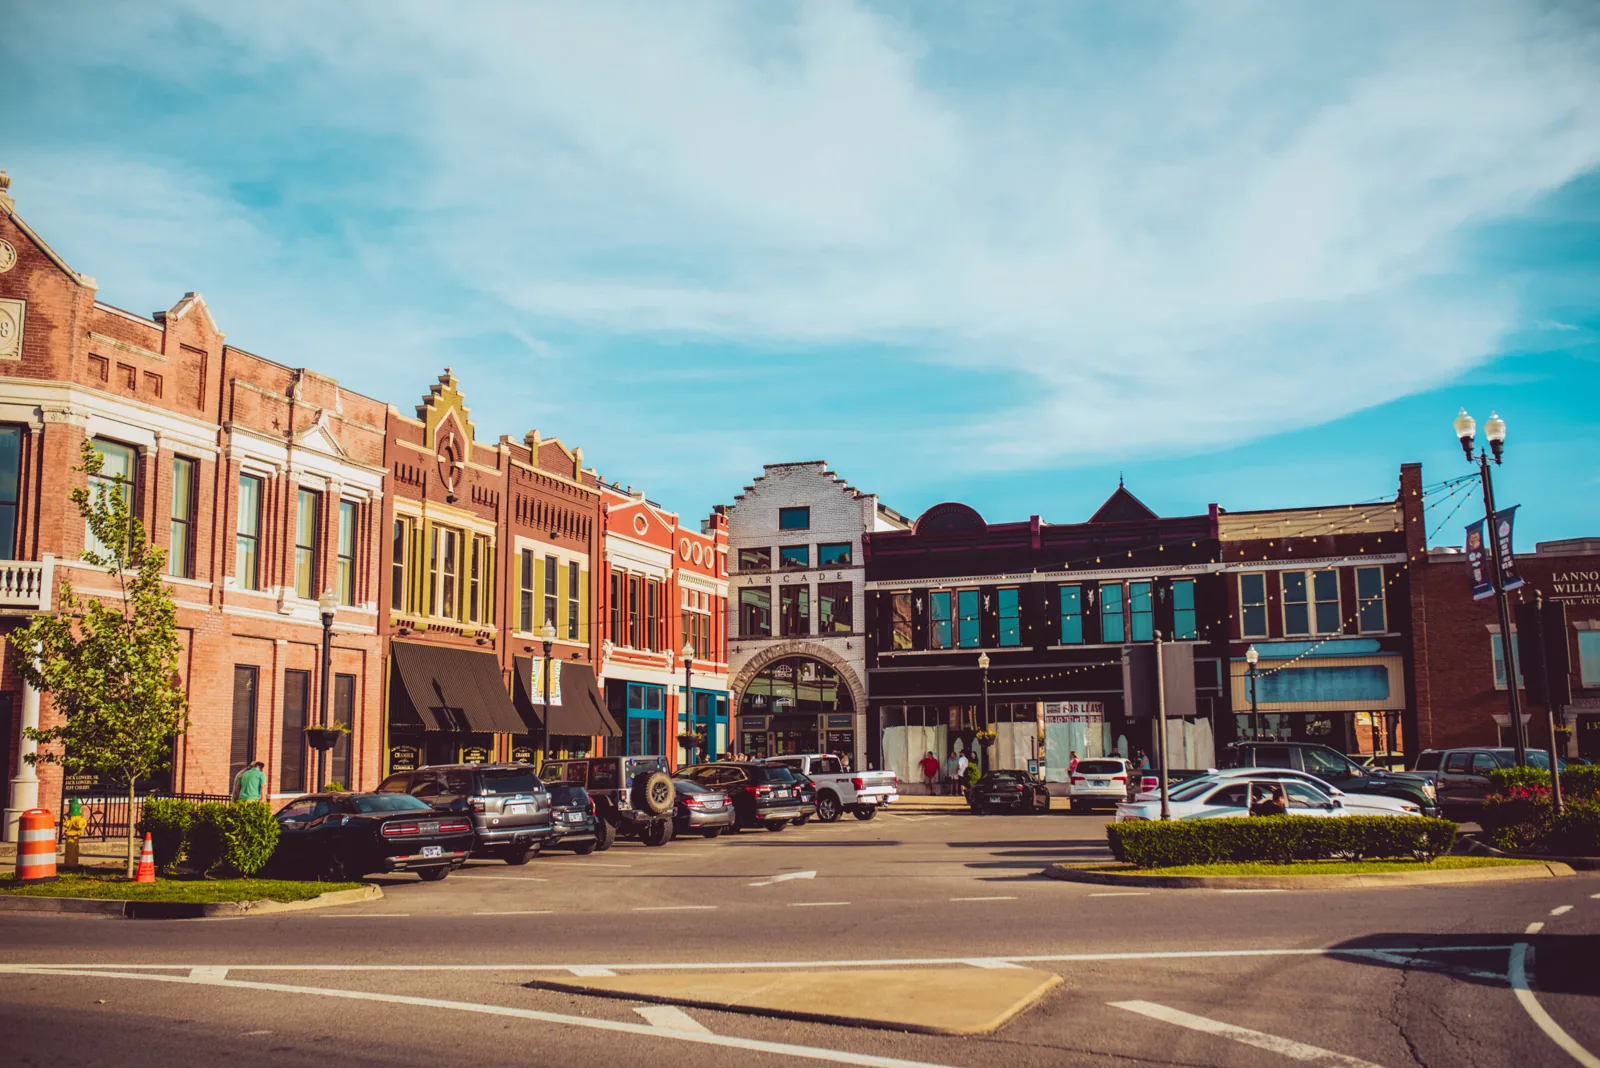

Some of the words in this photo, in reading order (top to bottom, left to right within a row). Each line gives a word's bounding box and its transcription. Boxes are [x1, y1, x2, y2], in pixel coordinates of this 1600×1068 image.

[747, 572, 843, 584] ARCADE
[1062, 704, 1078, 713] FOR
[1081, 703, 1102, 712] LEASE
